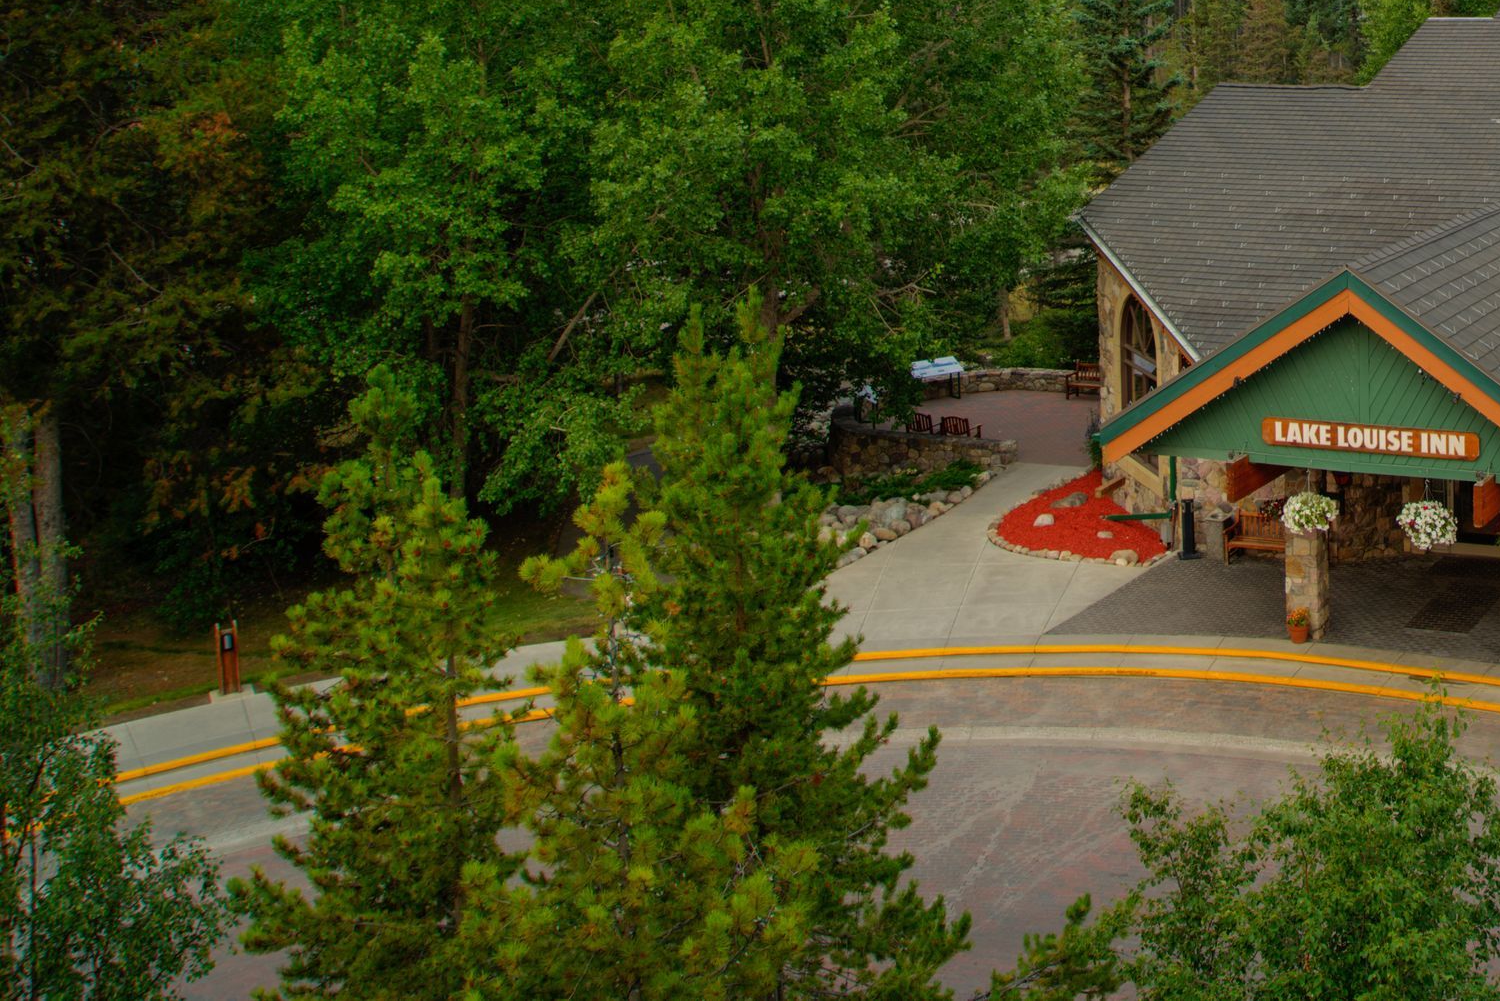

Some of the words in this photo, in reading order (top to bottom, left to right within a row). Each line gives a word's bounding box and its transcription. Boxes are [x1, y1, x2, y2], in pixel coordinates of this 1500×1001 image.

[1274, 421, 1331, 446] LAKE
[1336, 425, 1414, 452] LOUISE
[1420, 432, 1466, 456] INN
